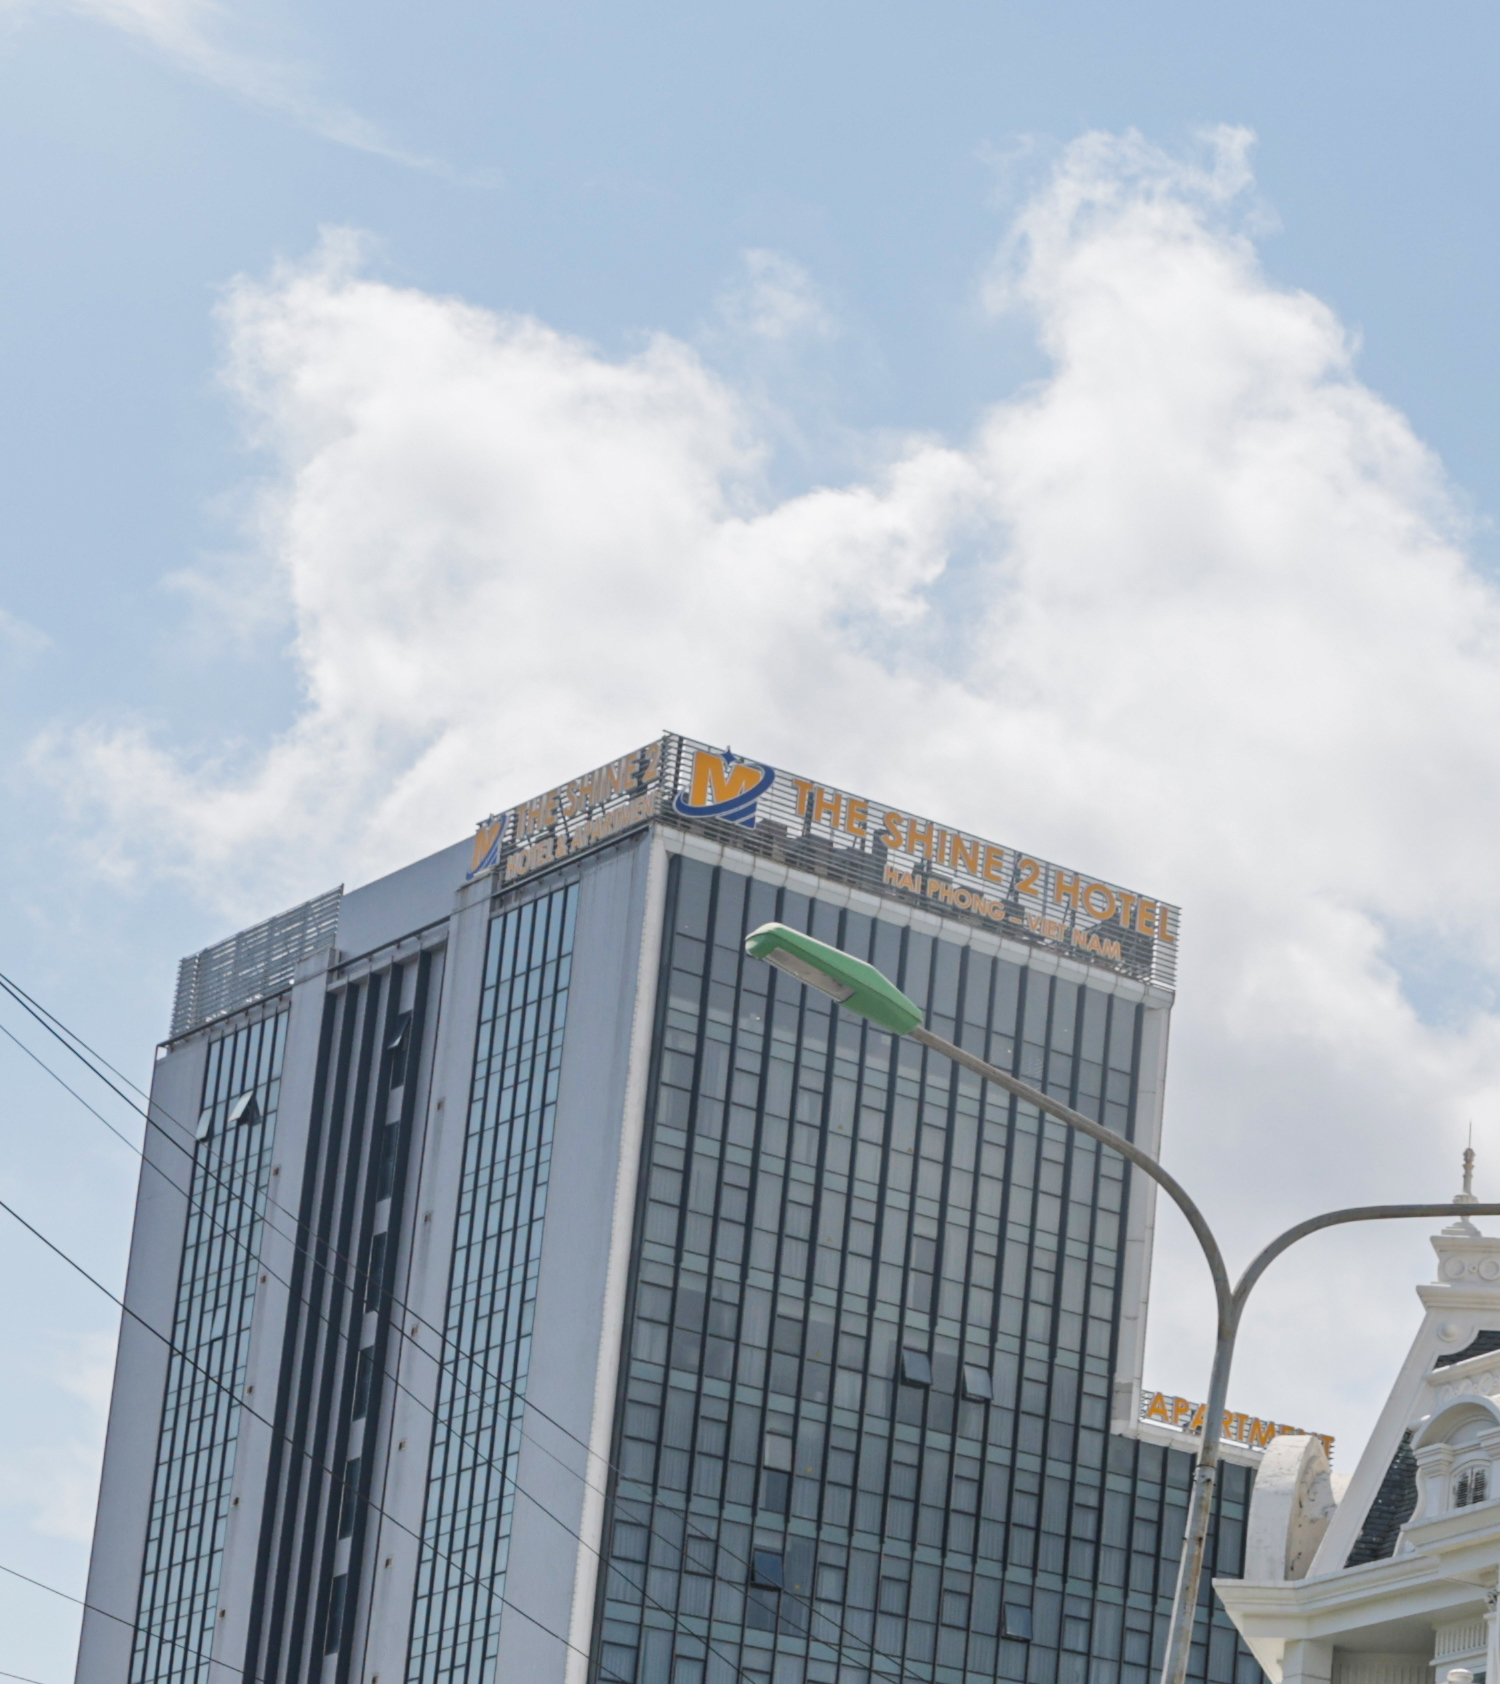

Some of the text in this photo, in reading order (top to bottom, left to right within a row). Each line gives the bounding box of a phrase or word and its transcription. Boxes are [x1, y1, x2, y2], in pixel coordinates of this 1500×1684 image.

[516, 788, 560, 839] THE
[562, 753, 640, 817] SHINE
[793, 779, 1176, 943] THE SHINE 2 HOTEL
[882, 865, 922, 894] HAI
[927, 879, 1005, 921] PHONG
[1026, 913, 1068, 942] VIET
[1071, 930, 1122, 961] NAM
